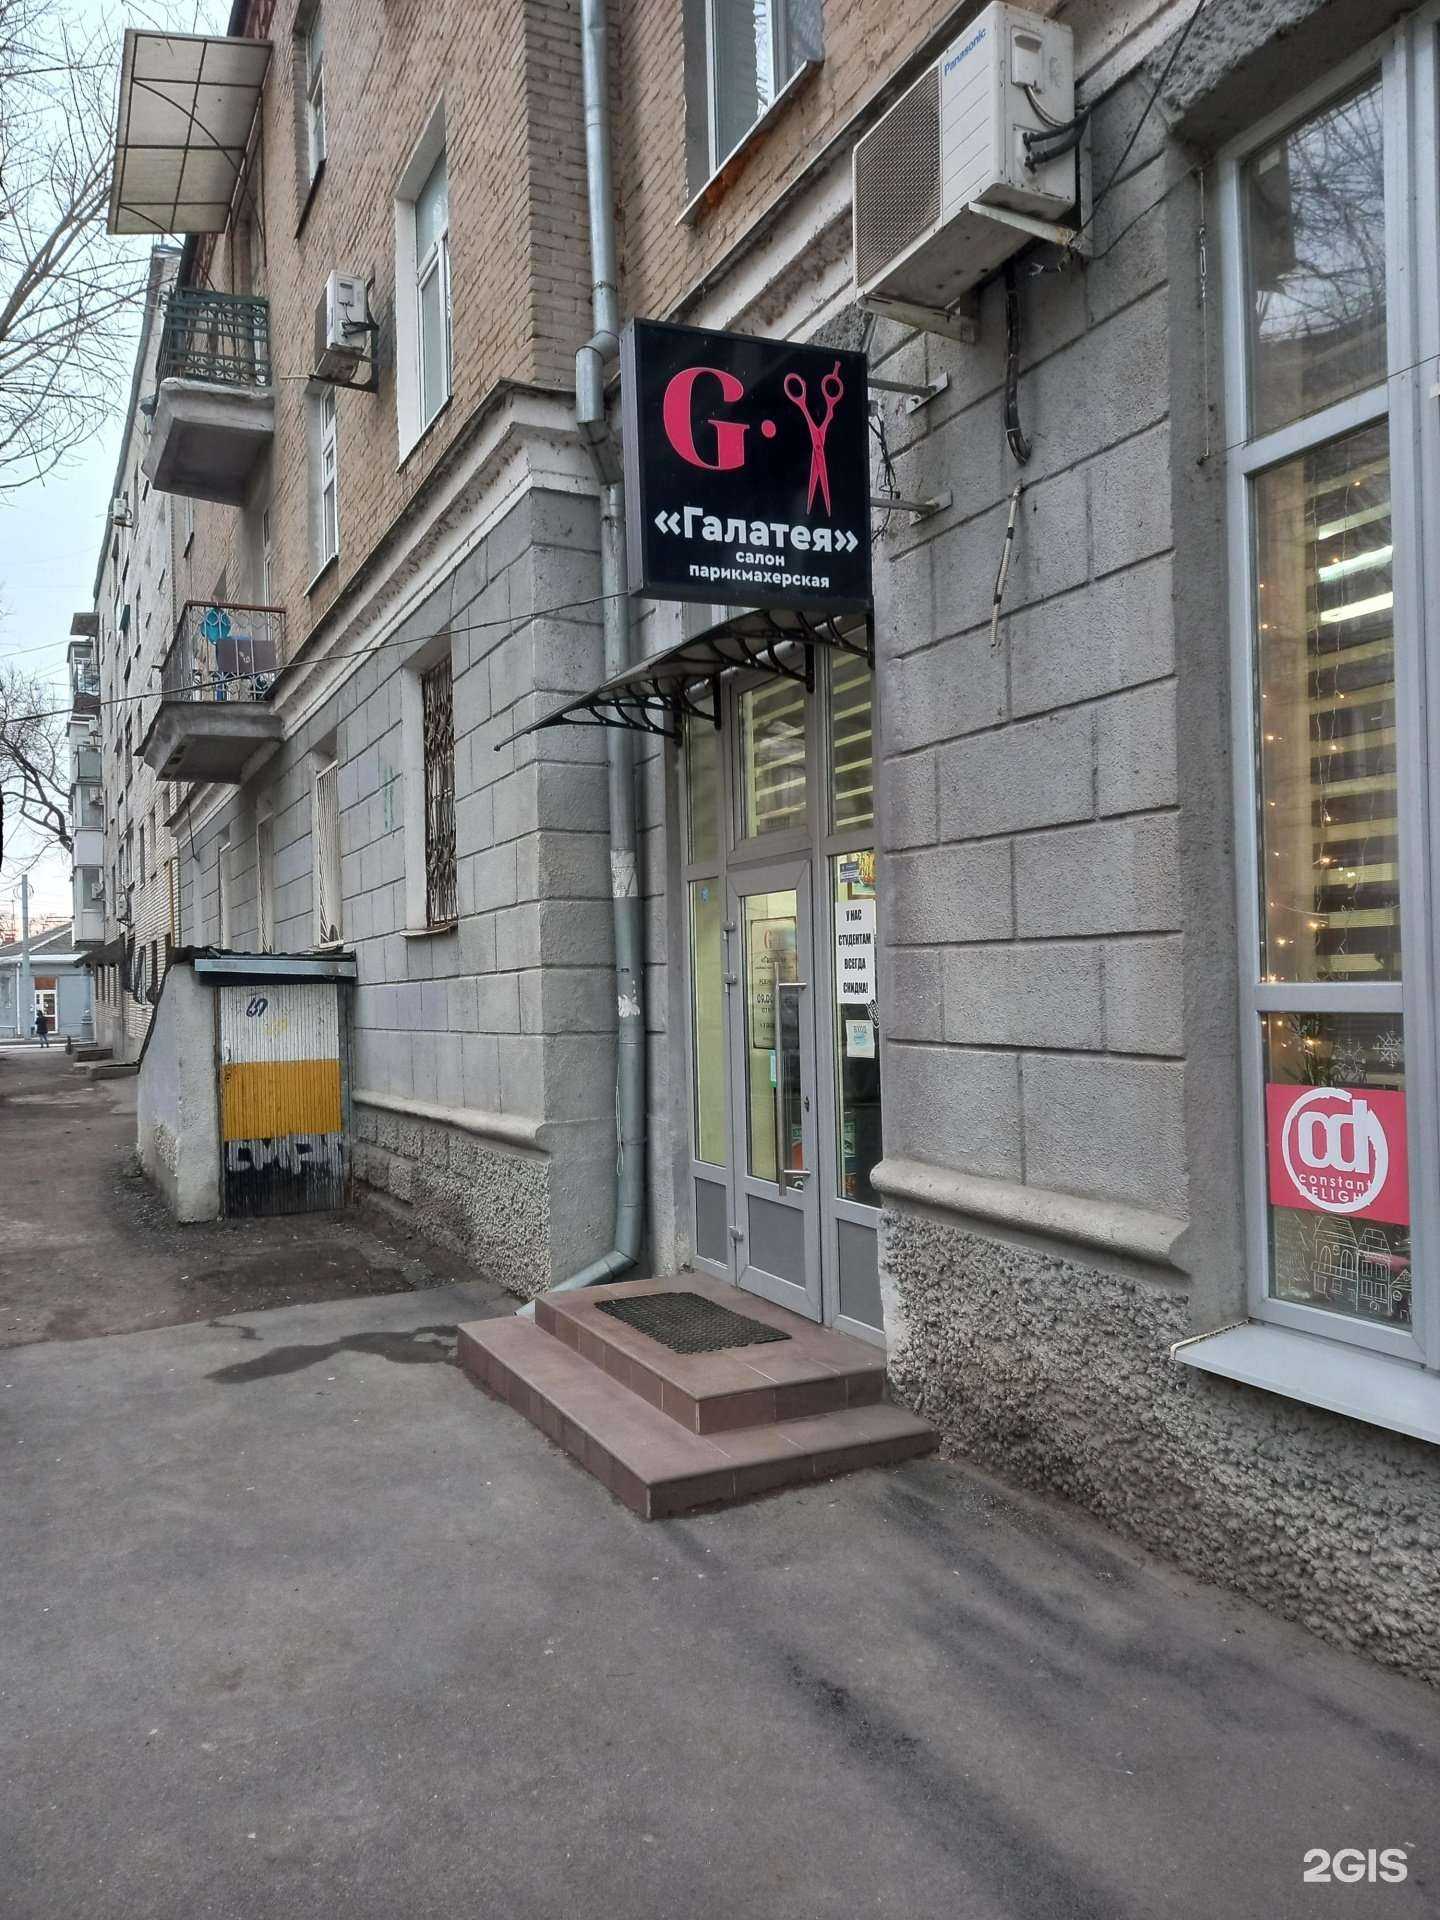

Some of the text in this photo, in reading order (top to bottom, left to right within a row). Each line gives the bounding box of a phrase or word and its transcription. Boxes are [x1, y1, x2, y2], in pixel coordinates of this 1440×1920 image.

[944, 28, 986, 77] Panasonic
[735, 551, 785, 566] салон
[689, 565, 830, 588] парикмахерская
[850, 909, 862, 920] НАС
[838, 933, 871, 947] СТУДЕНТАМ
[844, 957, 866, 970] ВСЕГДА
